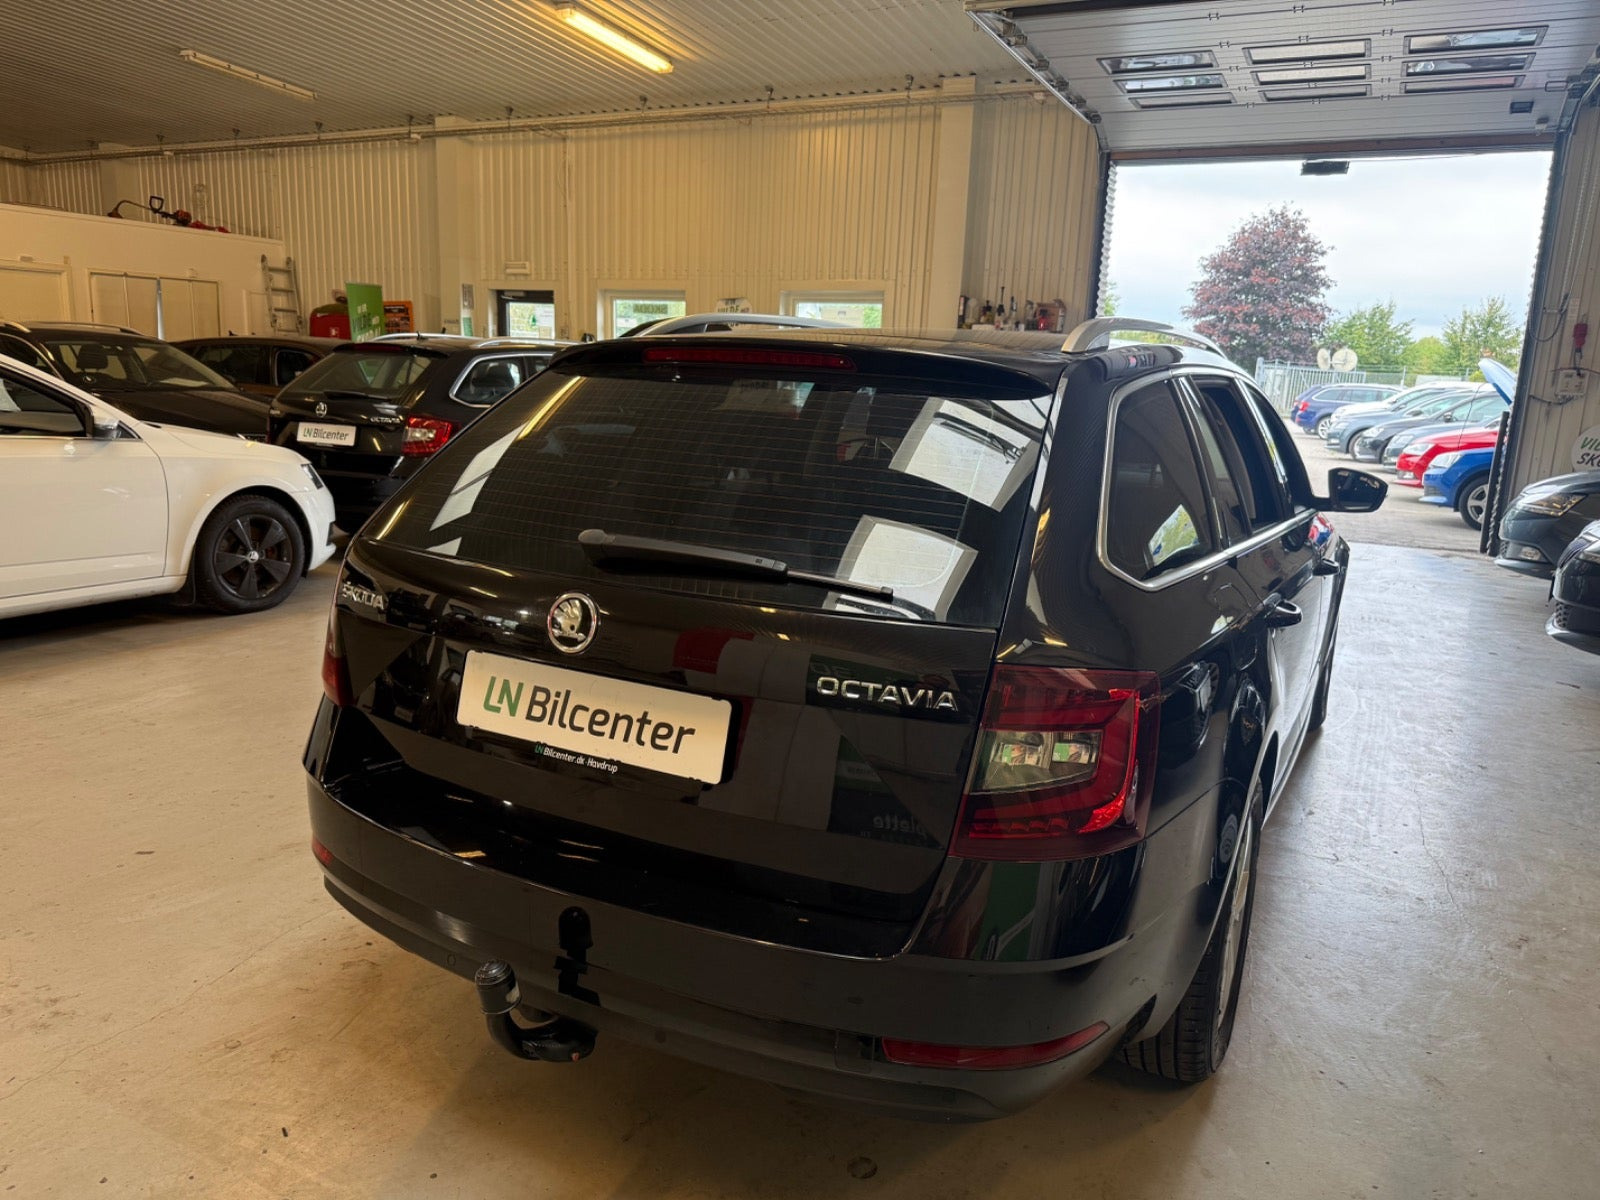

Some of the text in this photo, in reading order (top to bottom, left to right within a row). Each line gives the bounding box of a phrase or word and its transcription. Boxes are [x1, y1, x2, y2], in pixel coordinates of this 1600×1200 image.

[313, 428, 350, 441] Bilcenter
[816, 676, 959, 712] OCTAVIA
[483, 676, 696, 755] LN Bilcenter
